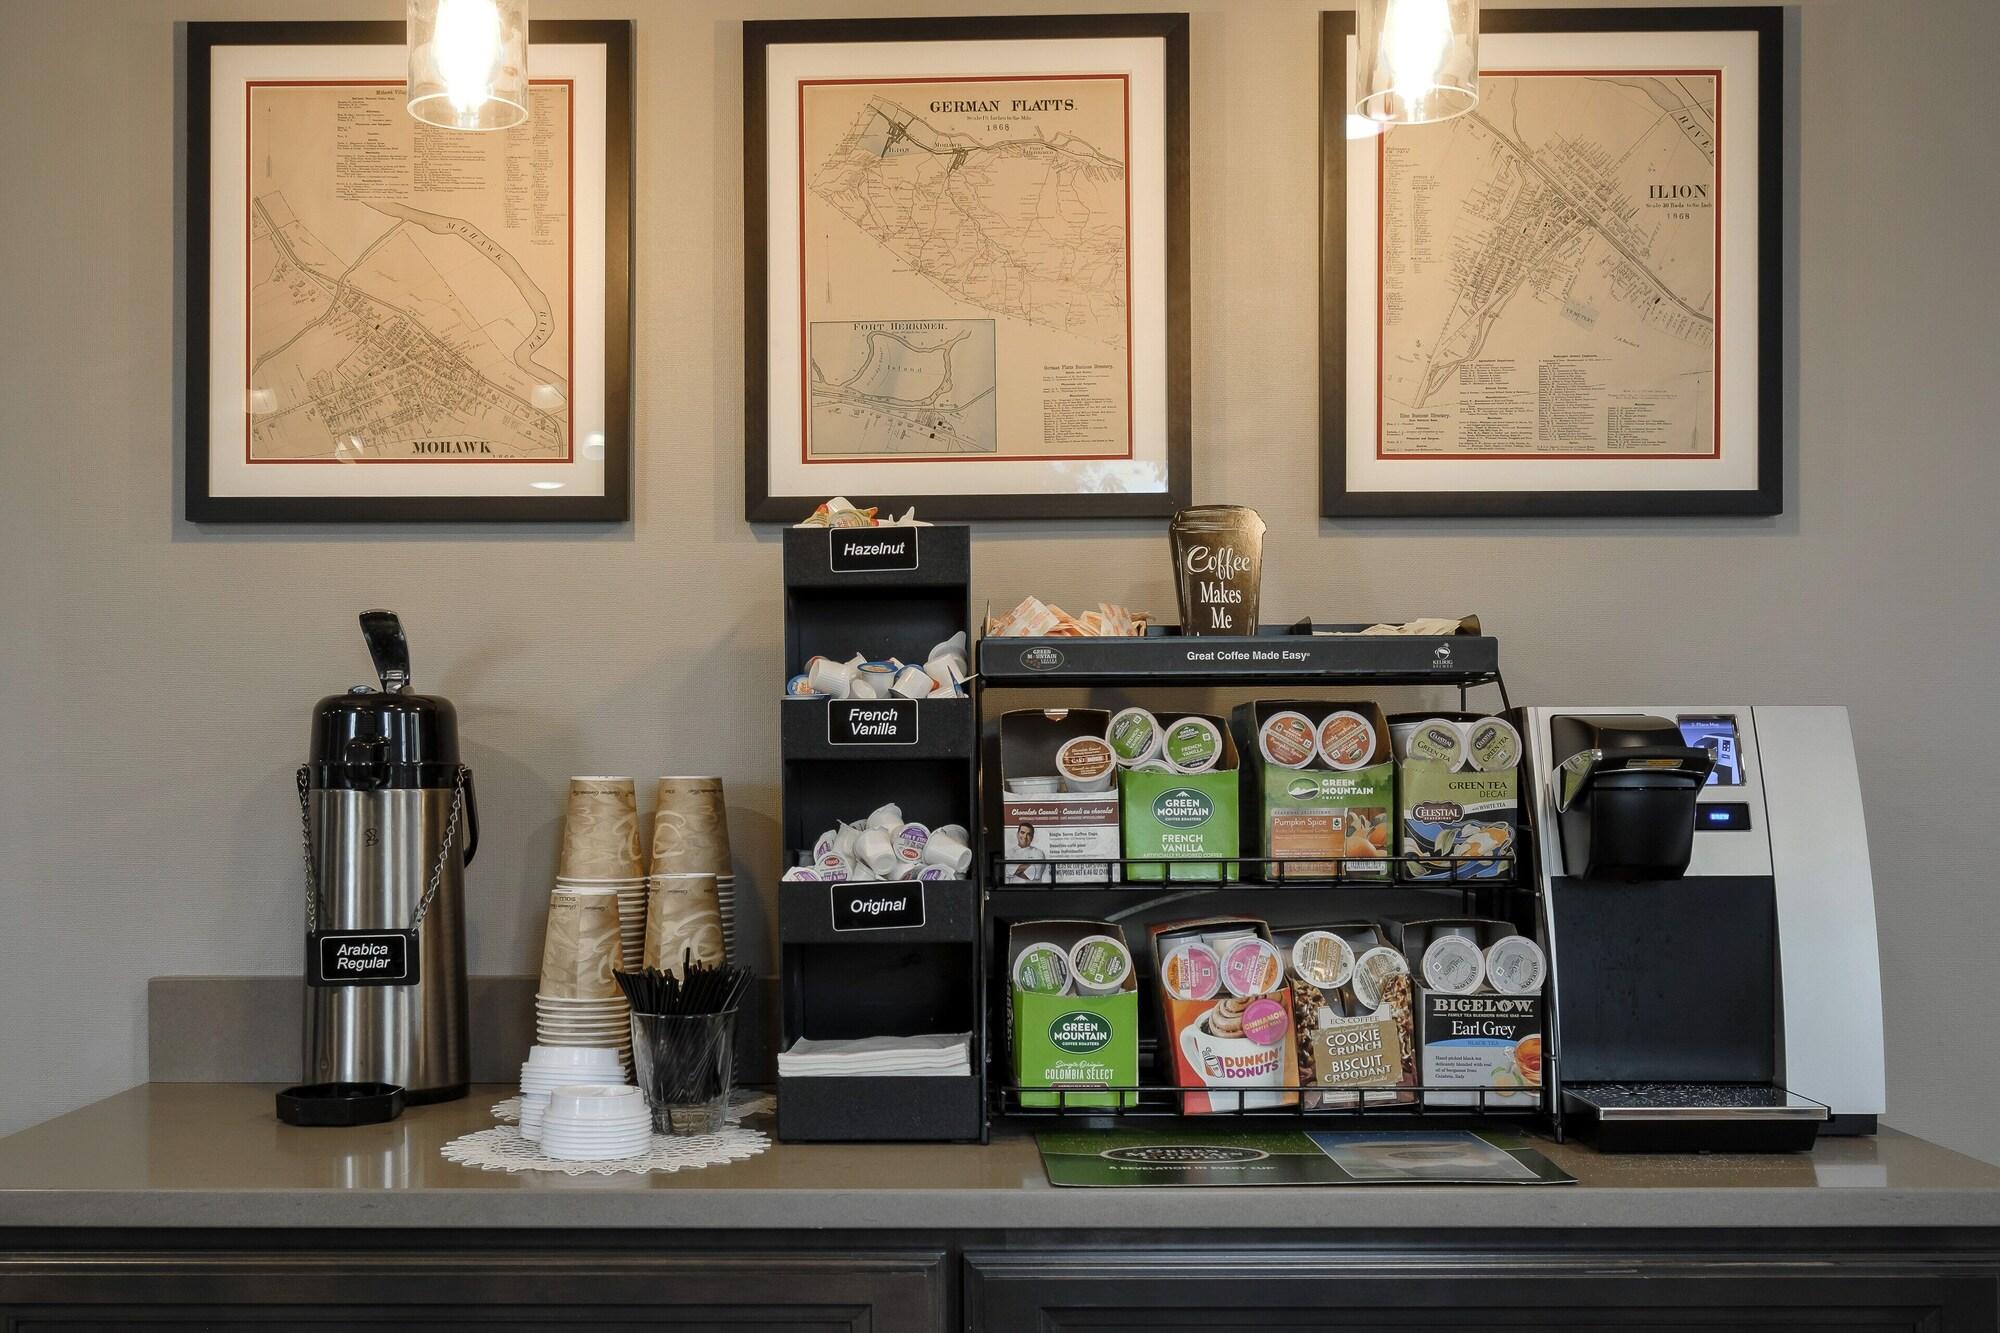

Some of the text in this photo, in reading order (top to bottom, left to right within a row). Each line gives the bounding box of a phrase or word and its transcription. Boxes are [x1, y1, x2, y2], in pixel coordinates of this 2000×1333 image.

[930, 99, 1078, 113] GERMAN FLATTS.
[1650, 184, 1707, 198] ILION
[446, 222, 504, 261] MOHAWK
[528, 311, 547, 350] RIVER
[854, 323, 885, 331] FORT
[413, 441, 492, 454] MOHAWK
[844, 541, 905, 556] Hazelnut
[1187, 546, 1251, 580] Coffee
[1200, 582, 1242, 603] Makes
[1211, 606, 1232, 629] Me
[1187, 651, 1214, 660] Great
[1217, 651, 1250, 660] Coffee
[1252, 651, 1280, 660] Made
[850, 708, 898, 721] French
[851, 722, 897, 736] Vanilla
[1430, 731, 1452, 748] CELESTIAL
[1182, 744, 1202, 752] FRENCH
[1417, 740, 1438, 756] GREEN
[1482, 736, 1509, 762] GREEN TEA
[1448, 781, 1485, 790] GREEN
[1165, 799, 1200, 807] GREEN
[1157, 808, 1209, 816] MOUNTAIN
[1415, 806, 1460, 817] CELESTIAL
[1274, 818, 1327, 827] Pumpkin Spice
[1162, 834, 1203, 842] FRENCH
[1162, 844, 1204, 852] VANILLA
[850, 897, 906, 914] Original
[336, 944, 388, 956] Arabica
[336, 957, 391, 971] Regular
[1063, 1023, 1098, 1031] GREEN
[1245, 1010, 1285, 1031] CINNAMON
[1054, 1032, 1107, 1040] MOUNTAIN
[1452, 1020, 1516, 1039] Earl Grey
[1326, 1029, 1380, 1046] COOKIE
[1328, 1041, 1382, 1056] CRUNCH
[1226, 1060, 1279, 1078] DONUTS
[1332, 1055, 1382, 1072] BISCUIT
[1045, 1069, 1114, 1080] COLOMBIA SELECT
[1324, 1064, 1391, 1082] CROQUANT
